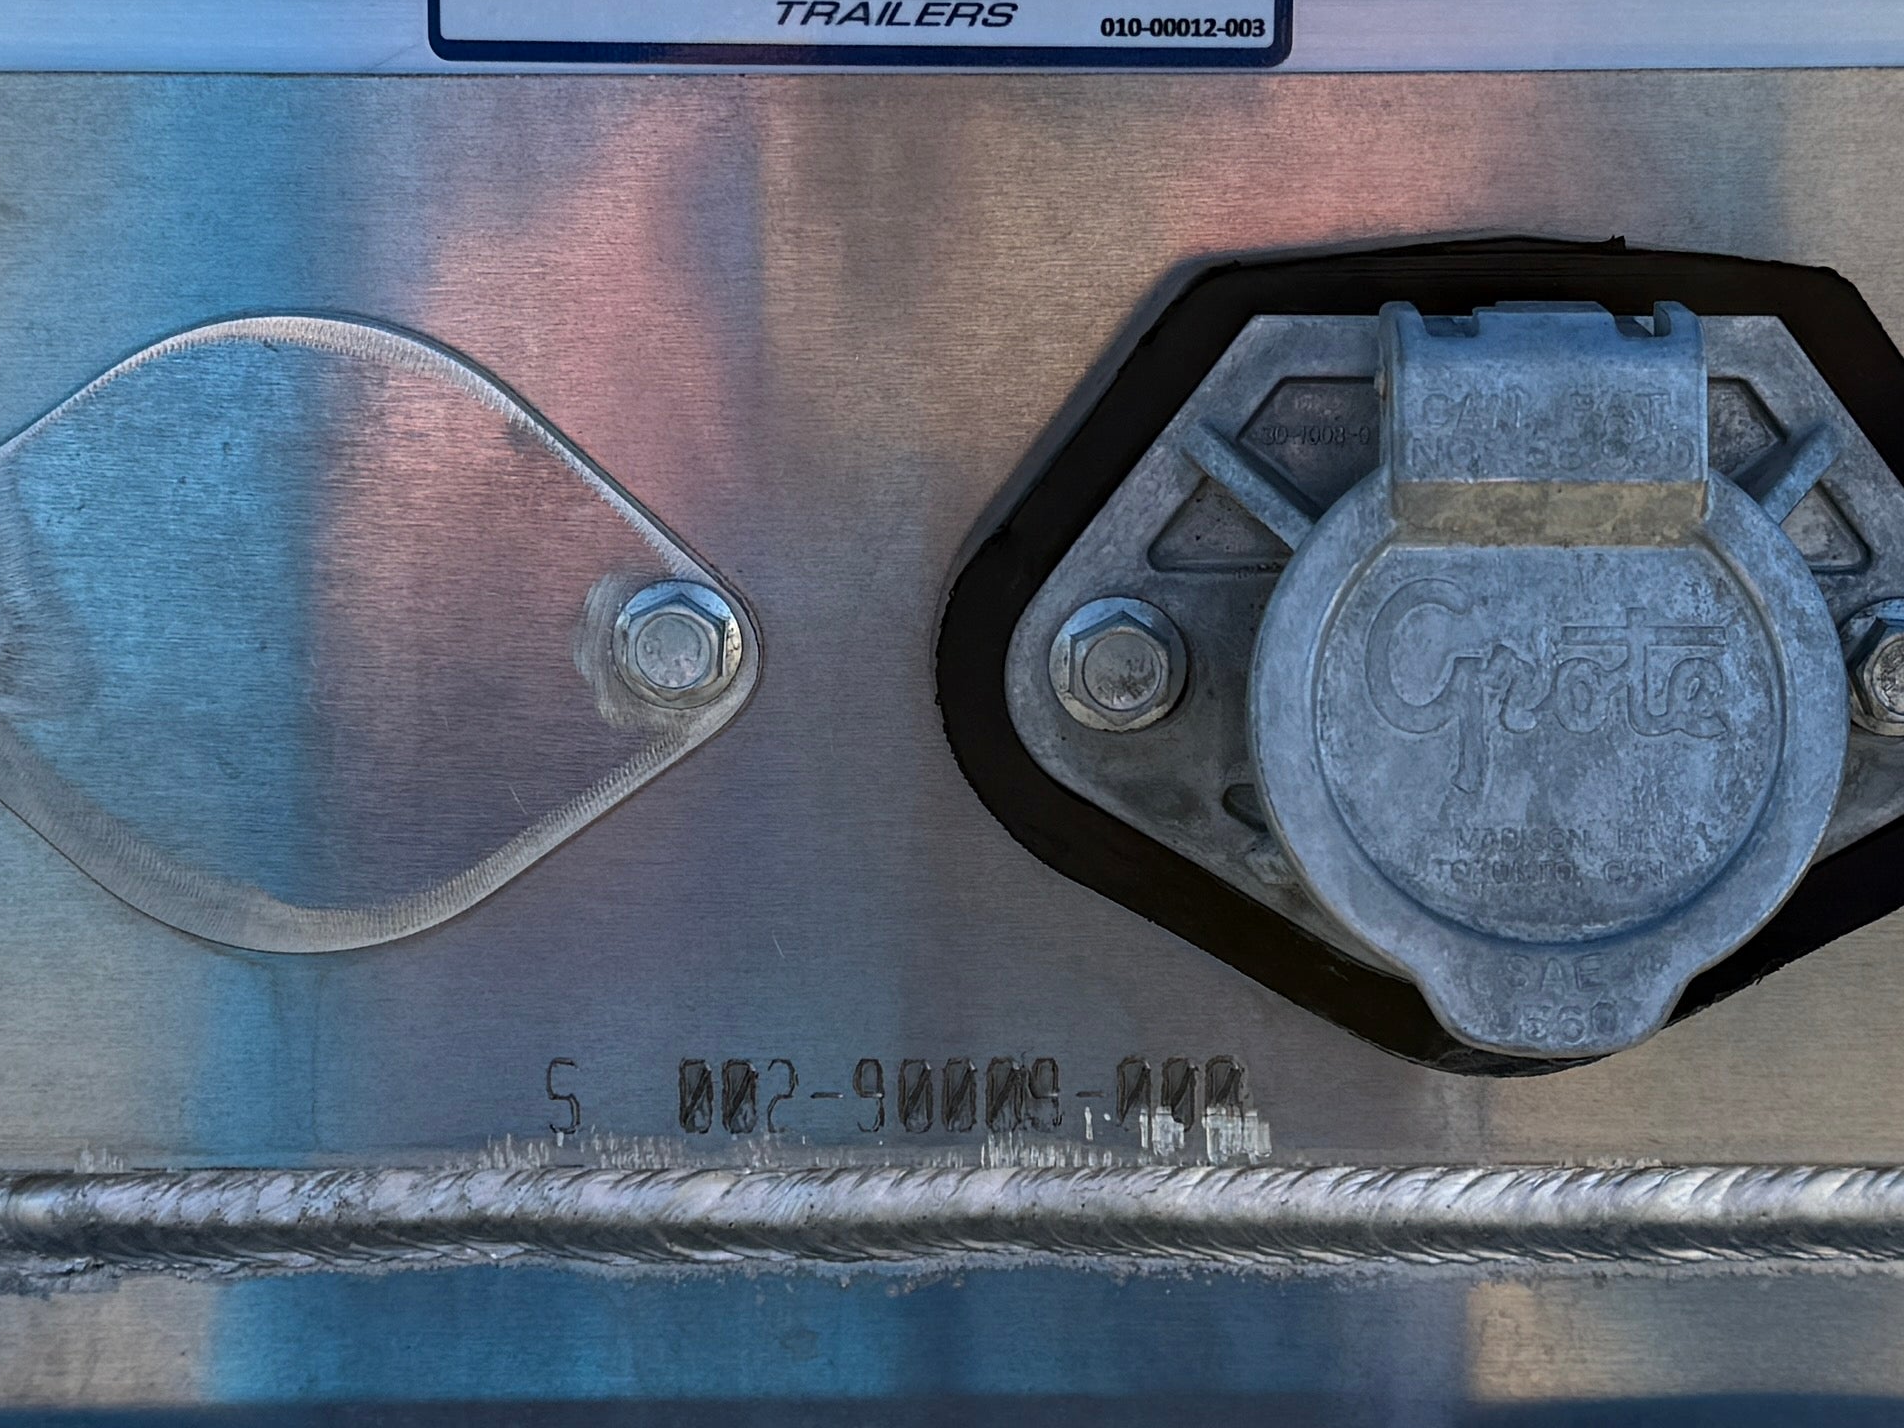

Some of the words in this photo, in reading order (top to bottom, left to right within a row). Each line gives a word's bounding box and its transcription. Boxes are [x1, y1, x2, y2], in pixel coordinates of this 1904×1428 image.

[776, 0, 1020, 28] TRAILERS
[1100, 16, 1267, 39] 010-00012-003
[1365, 578, 1729, 794] Grote
